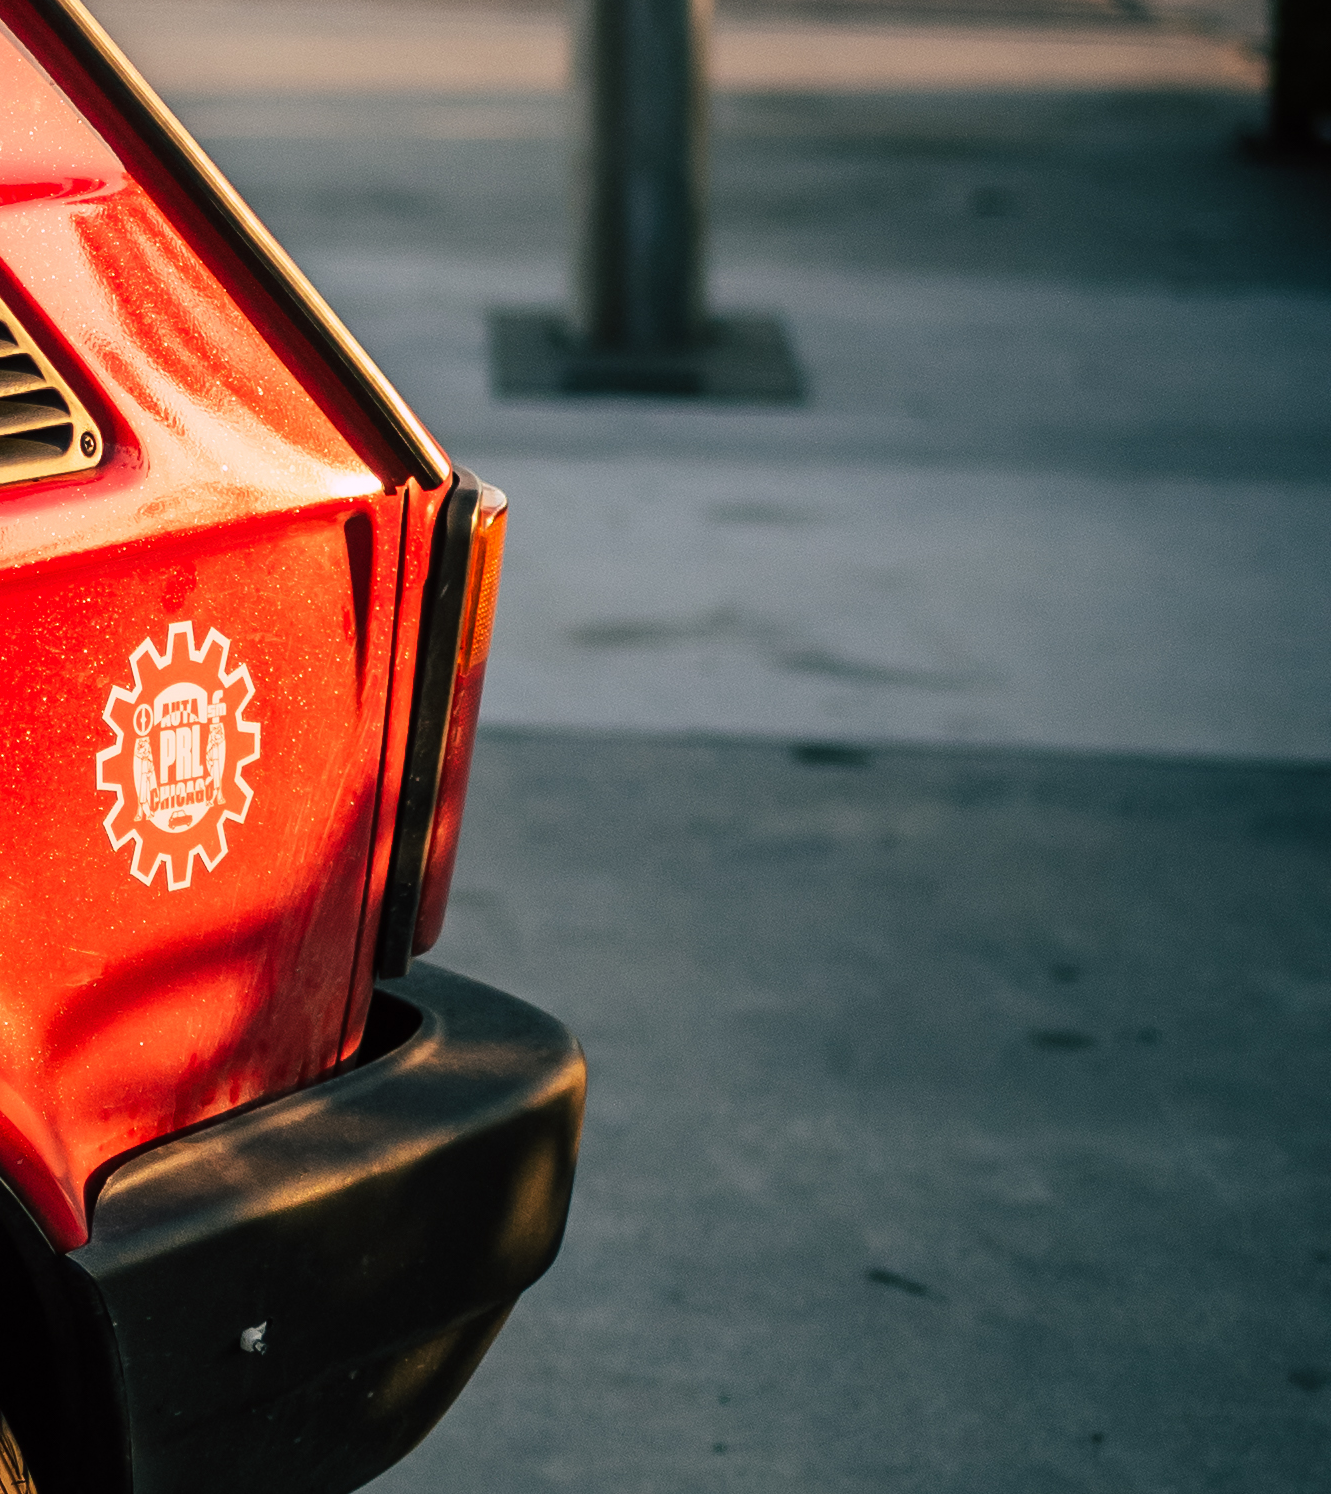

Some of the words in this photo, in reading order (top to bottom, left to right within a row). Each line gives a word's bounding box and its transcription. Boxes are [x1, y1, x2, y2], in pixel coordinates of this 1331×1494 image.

[160, 698, 200, 728] AUTA
[159, 725, 204, 784] PRL
[149, 776, 215, 812] CHICAGO
